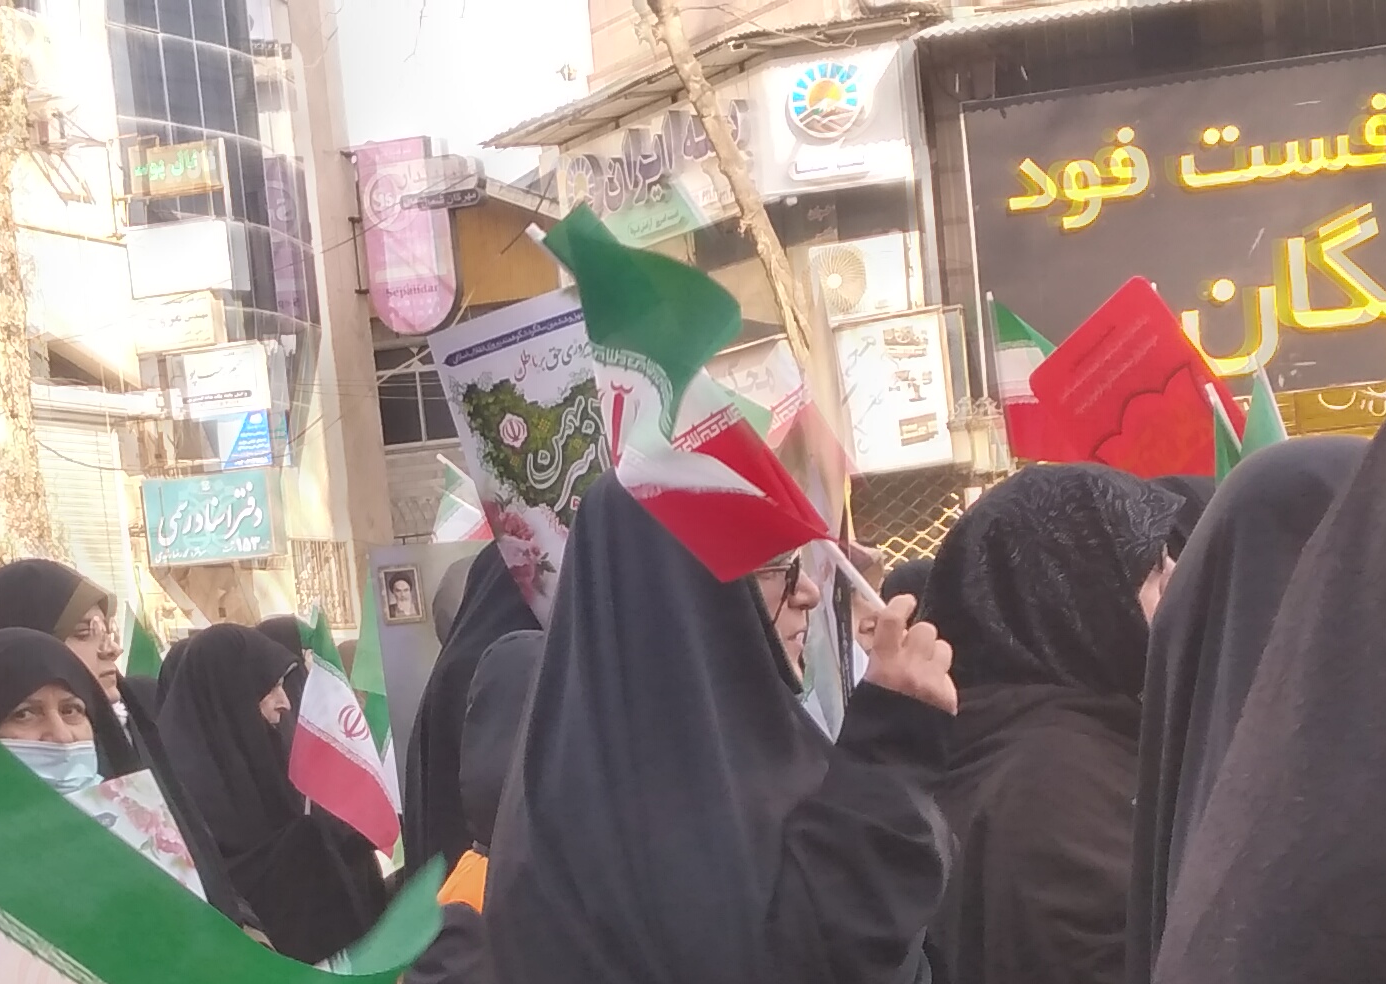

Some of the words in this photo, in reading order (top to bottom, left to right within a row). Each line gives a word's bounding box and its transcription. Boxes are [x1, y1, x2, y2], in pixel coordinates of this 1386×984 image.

[604, 109, 674, 213] ایران
[1008, 126, 1150, 231] فود
[157, 501, 192, 546] رسمی
[194, 497, 233, 534] اسناد
[224, 481, 263, 540] دفتر
